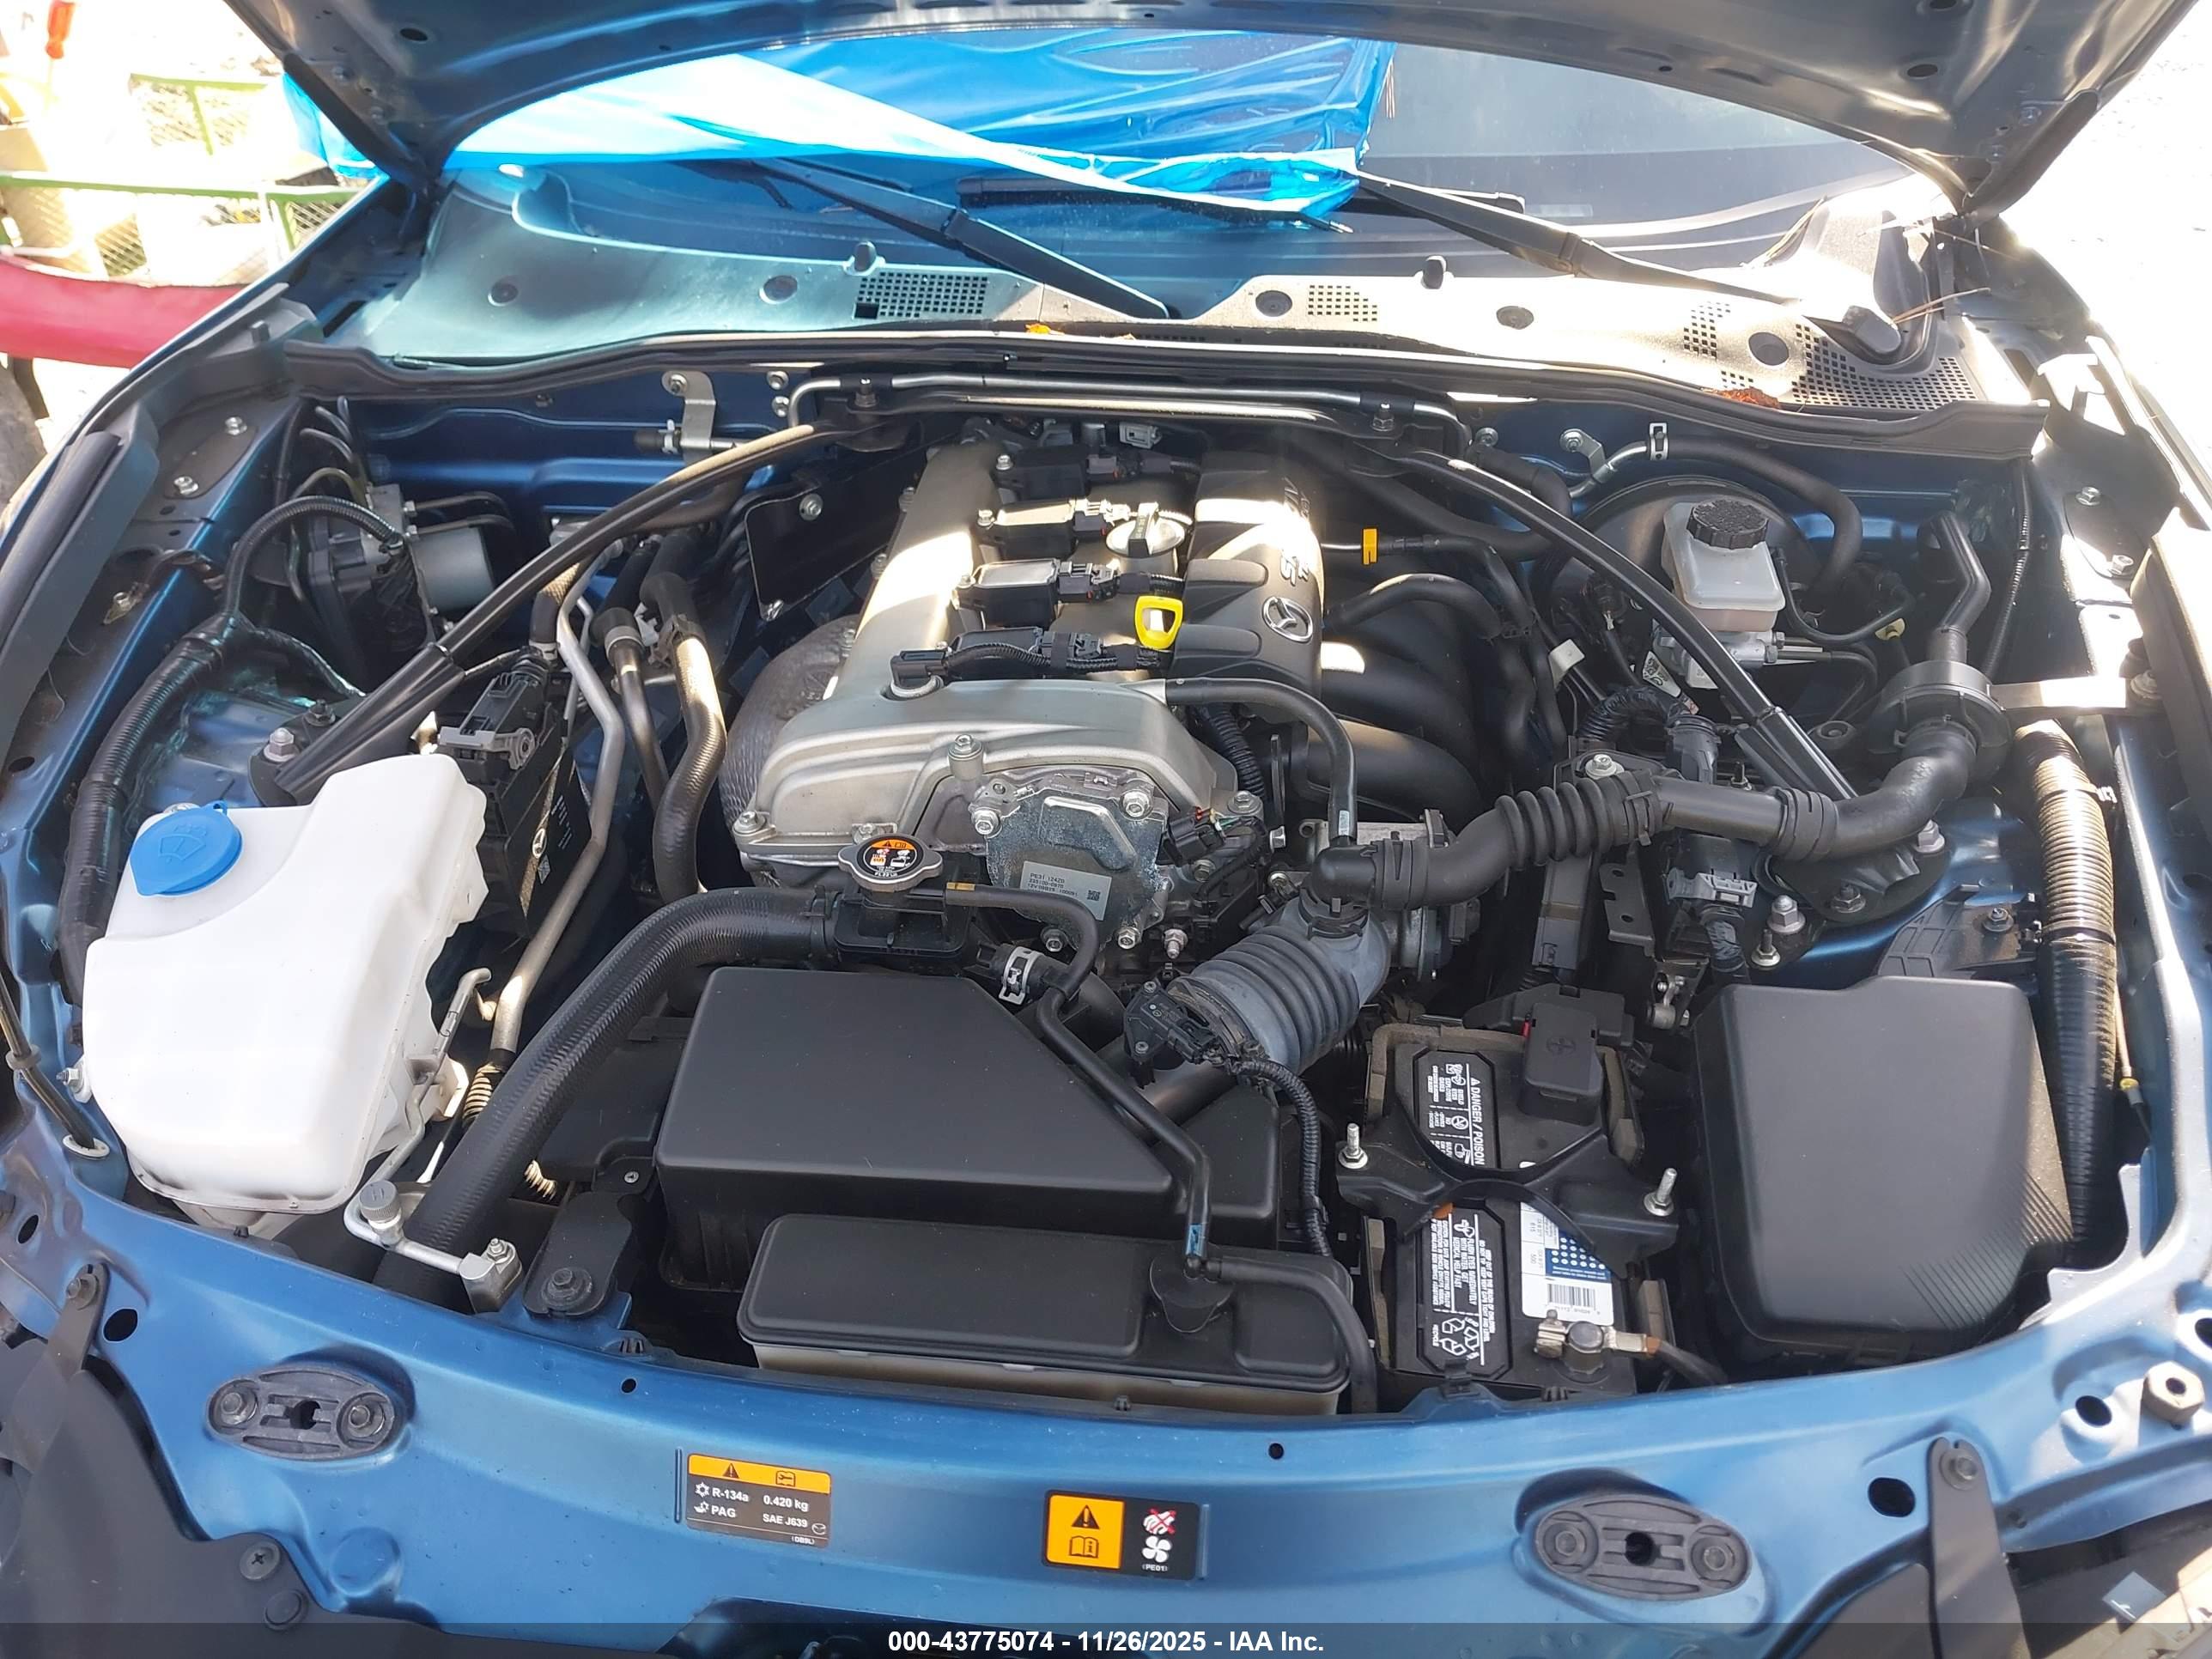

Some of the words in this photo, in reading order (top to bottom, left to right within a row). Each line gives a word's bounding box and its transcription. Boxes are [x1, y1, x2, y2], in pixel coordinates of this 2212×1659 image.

[1471, 1087, 1481, 1122] DANGER
[1474, 1131, 1485, 1164] POISON
[712, 1487, 749, 1502] R-134a
[763, 1495, 793, 1508] 0.420
[794, 1498, 809, 1512] kg
[711, 1505, 736, 1517] PAG
[763, 1514, 784, 1524] SAE
[785, 1517, 808, 1528] J639
